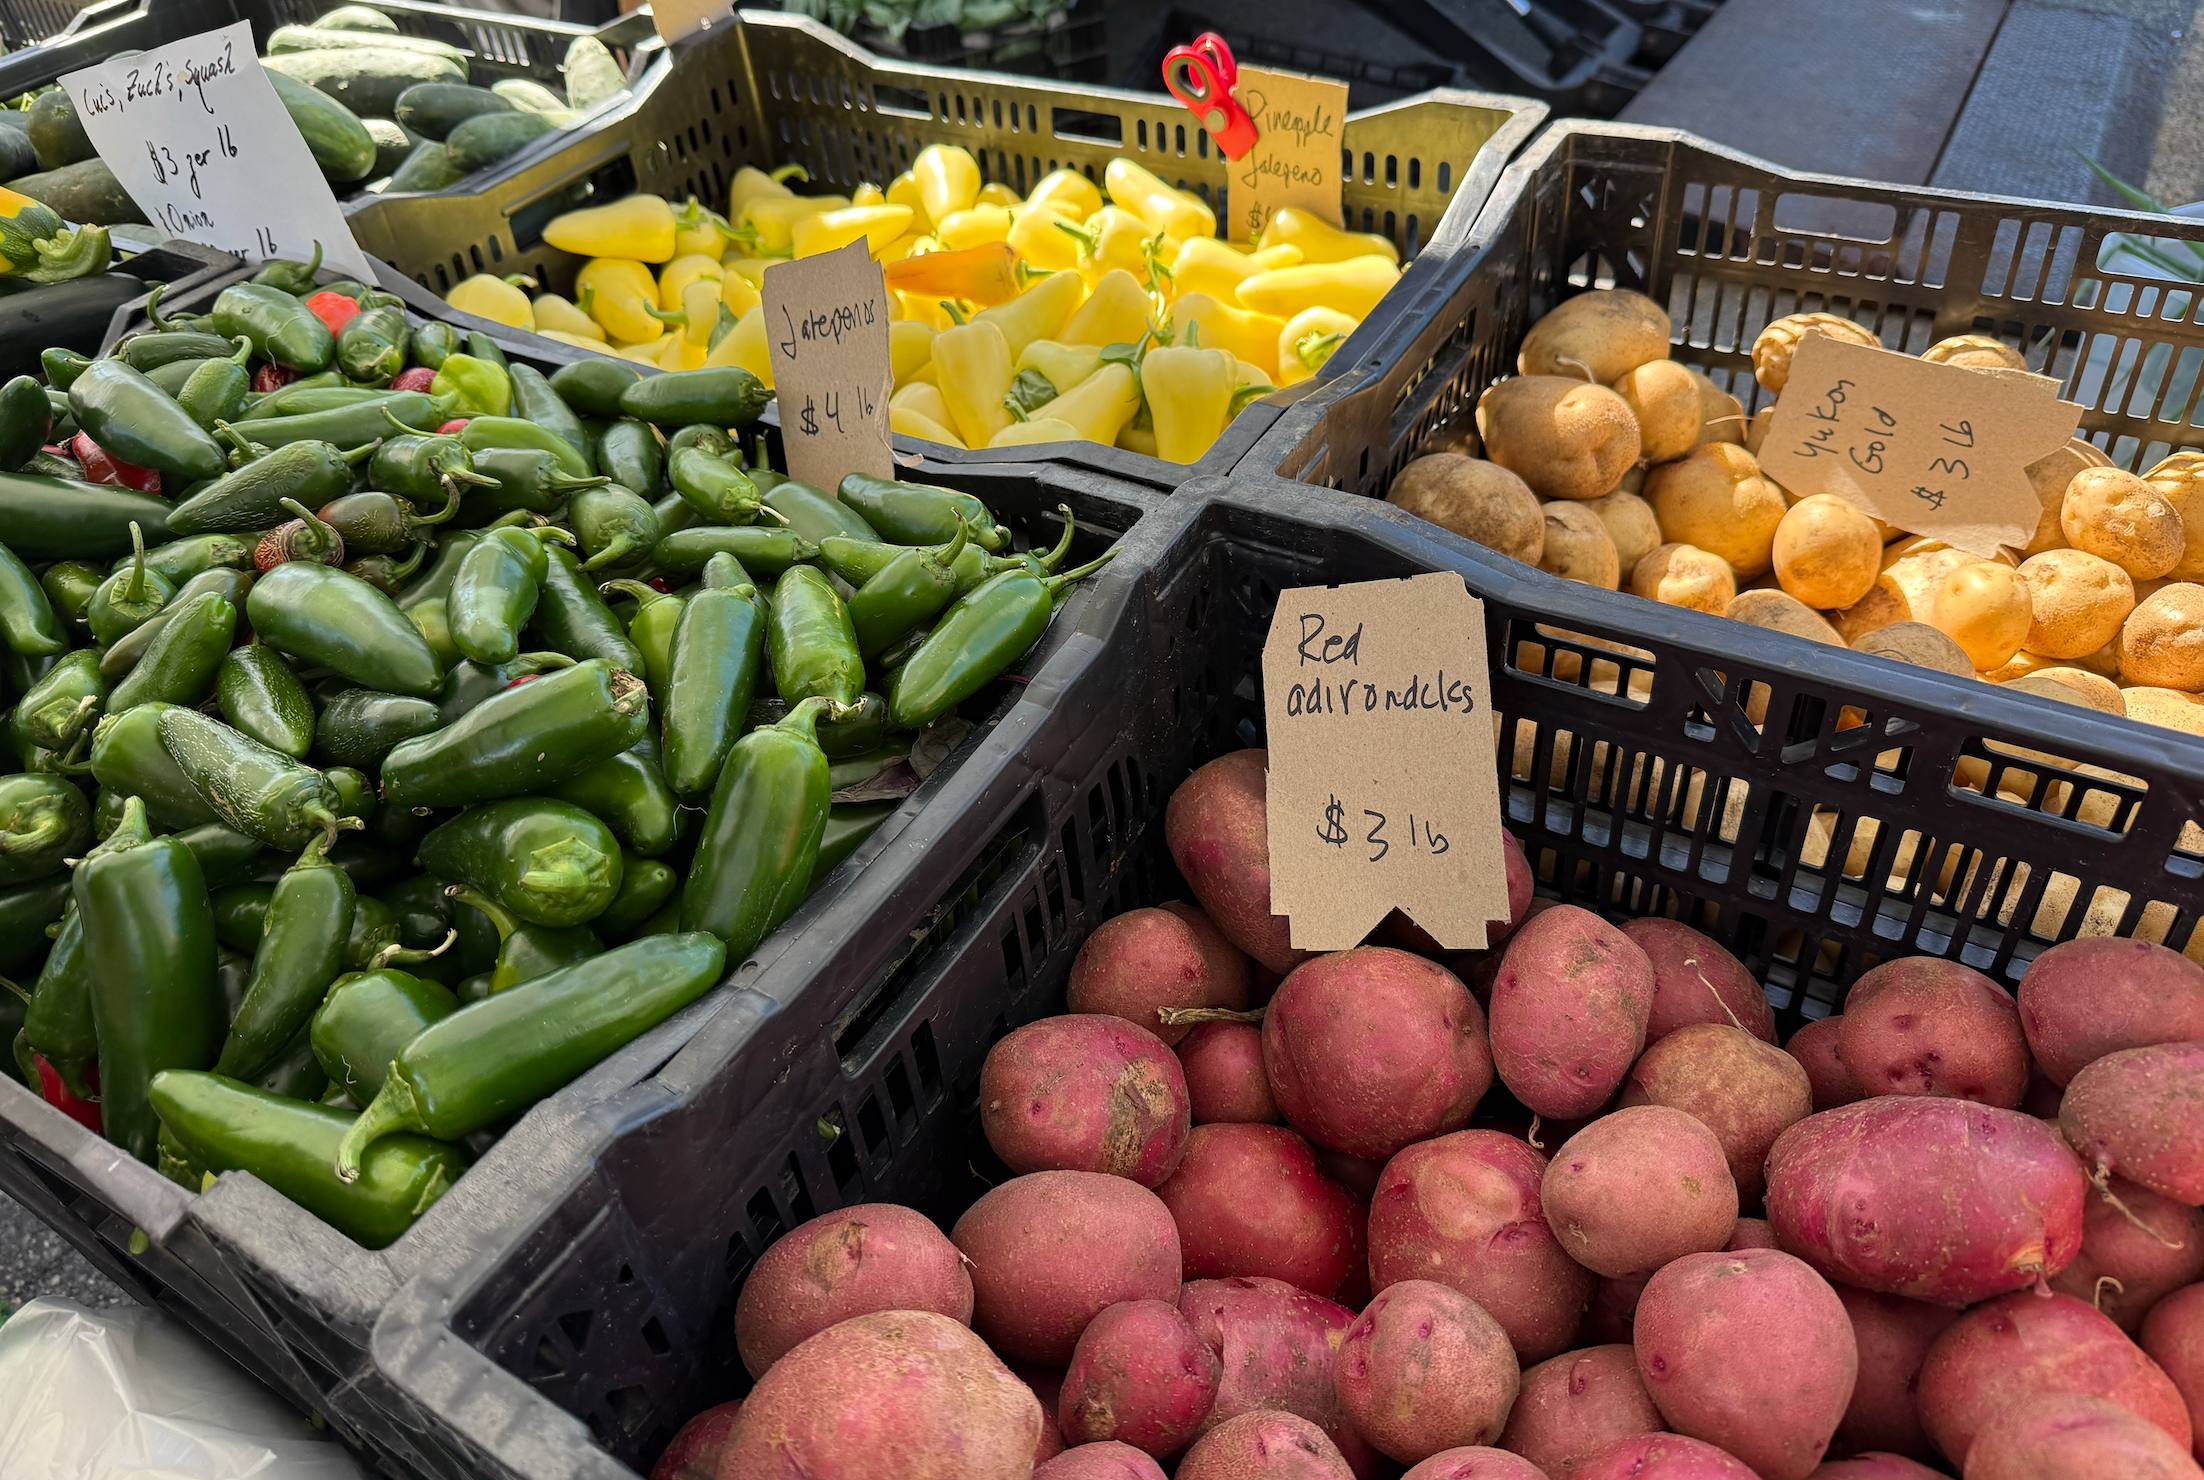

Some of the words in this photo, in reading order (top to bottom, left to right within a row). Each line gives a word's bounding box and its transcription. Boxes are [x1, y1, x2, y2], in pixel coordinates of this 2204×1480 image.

[185, 41, 236, 115] Squash
[216, 124, 239, 159] lb
[256, 226, 279, 258] lb
[856, 385, 874, 420] lb
[1848, 406, 1897, 474] Gold
[1939, 419, 1975, 449] lb
[1297, 613, 1364, 667] Red
[1409, 813, 1450, 855] lb
